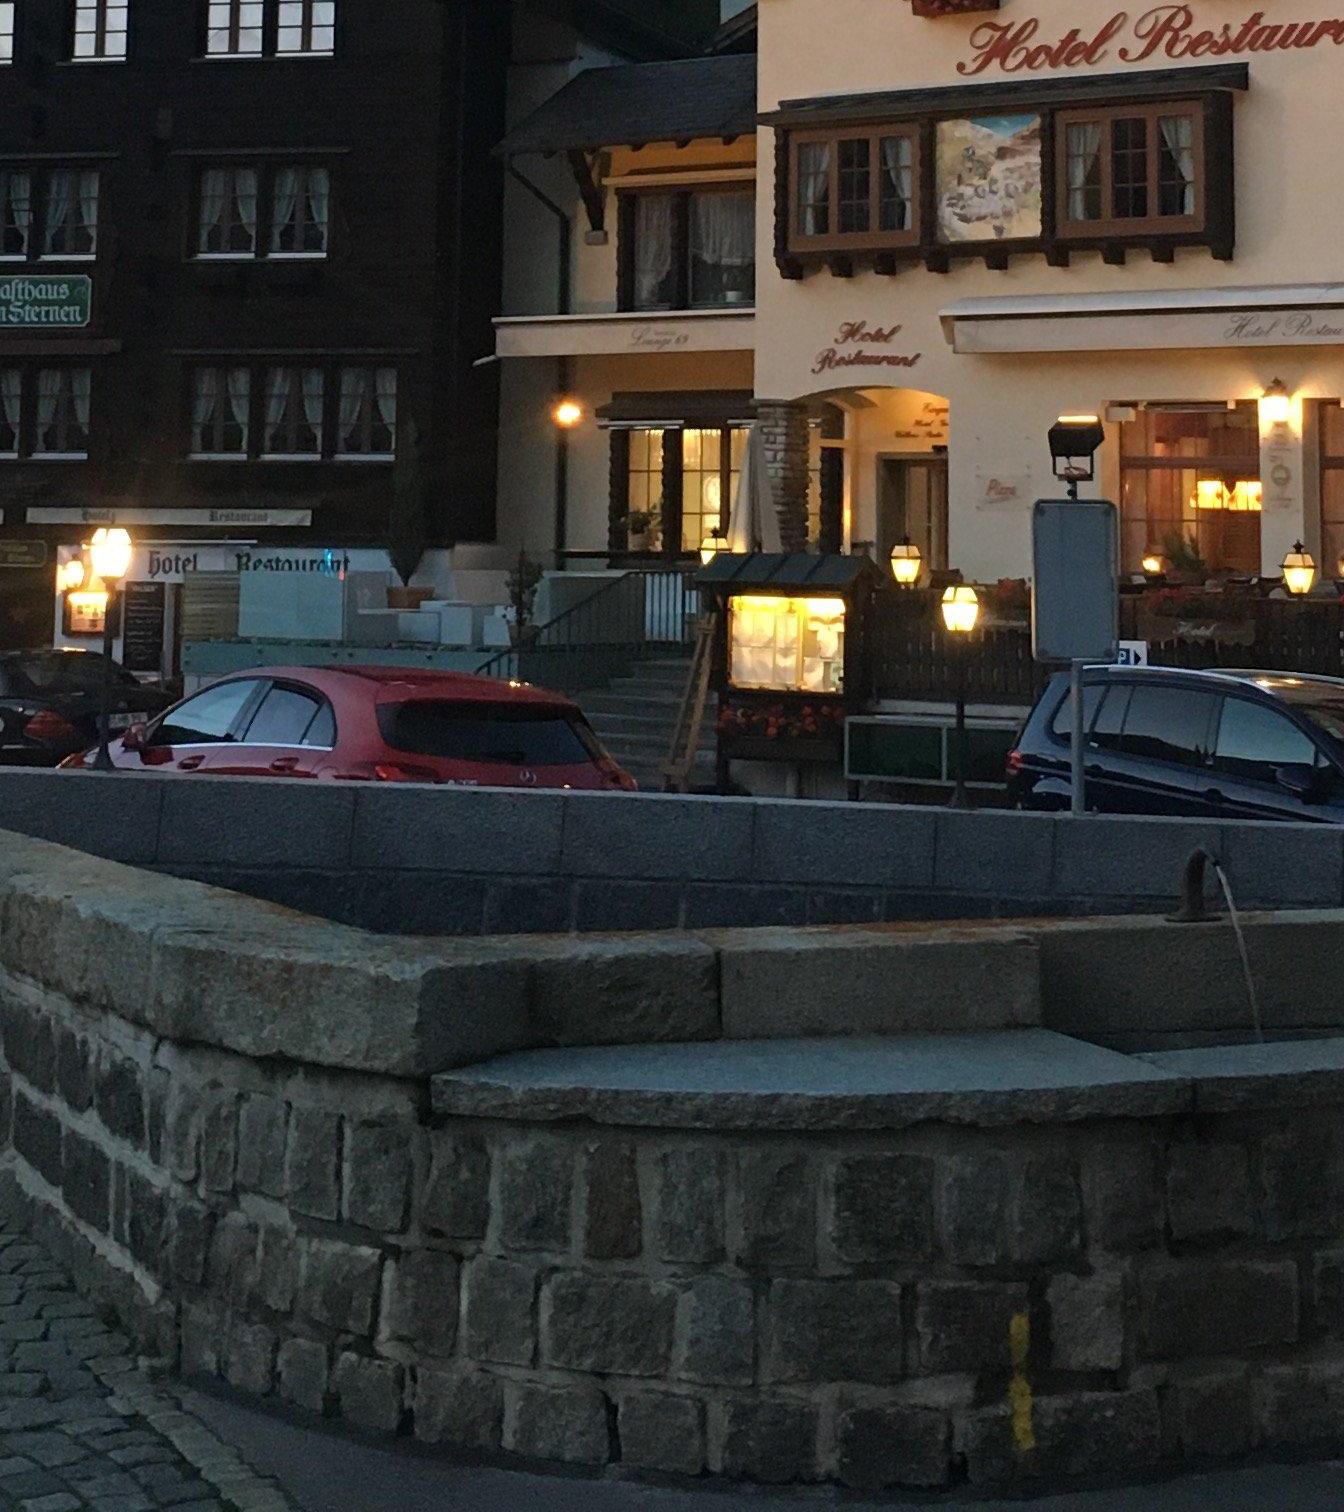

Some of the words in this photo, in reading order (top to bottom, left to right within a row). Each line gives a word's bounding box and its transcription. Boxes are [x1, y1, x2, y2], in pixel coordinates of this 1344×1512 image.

[956, 11, 1127, 76] Hotel
[8, 301, 82, 323] Sternen
[834, 320, 902, 345] Hotel
[1224, 313, 1281, 338] Hotel
[811, 348, 923, 375] Restaurant
